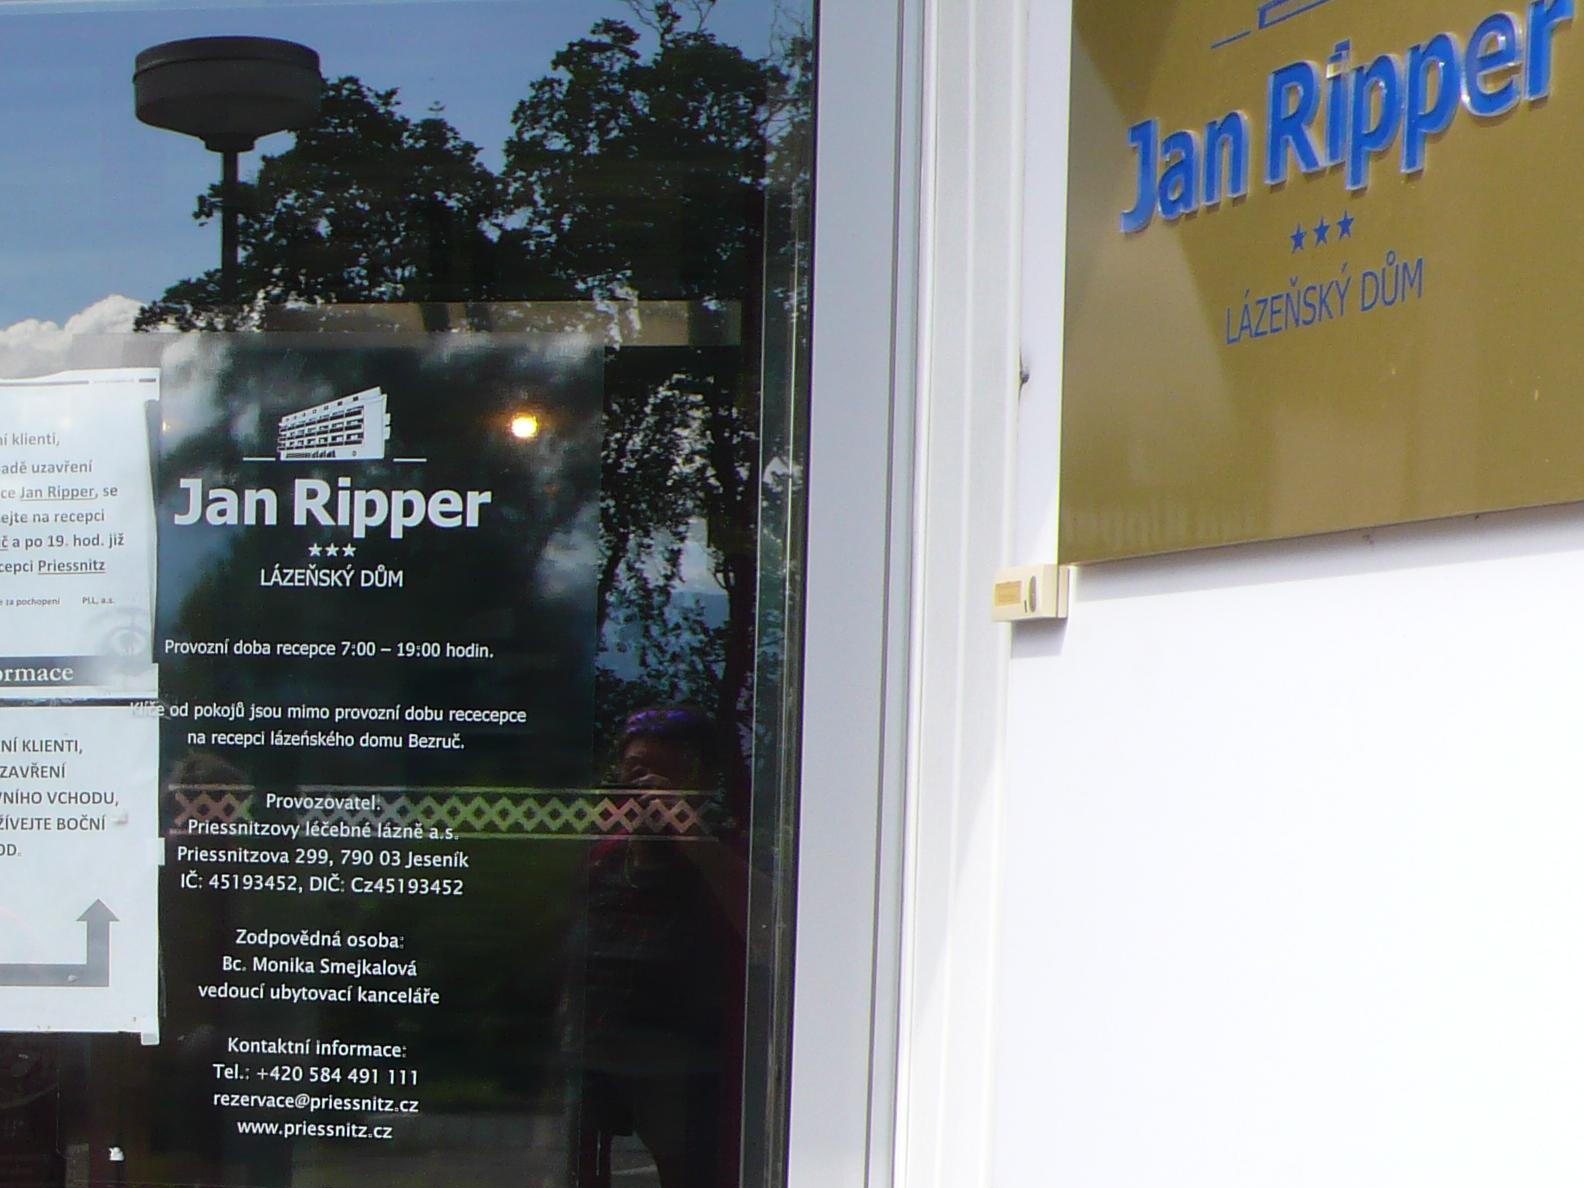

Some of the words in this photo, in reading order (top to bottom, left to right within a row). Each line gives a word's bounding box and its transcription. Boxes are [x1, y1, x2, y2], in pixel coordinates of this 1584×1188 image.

[1119, 106, 1250, 236] Jan
[1264, 0, 1575, 191] Ripper
[1225, 262, 1353, 345] LÁZEŇSKÝ
[1360, 249, 1424, 313] DŮM
[12, 432, 60, 446] klienti,
[31, 460, 92, 474] uzavření
[20, 488, 42, 499] Jan
[48, 486, 98, 499] Ripper,
[102, 486, 118, 496] se
[32, 513, 49, 523] na
[54, 509, 105, 525] recepci
[173, 478, 278, 526] Jan
[293, 477, 491, 539] Ripper
[12, 538, 20, 548] a
[25, 537, 42, 550] po
[47, 535, 68, 548] 19.
[73, 534, 104, 547] hod.
[108, 534, 124, 549] již
[38, 559, 105, 572] Priessnitz
[260, 564, 354, 588] LÁZEŇSKÝ
[361, 564, 403, 588] DŮM
[165, 639, 229, 655] Provozní
[234, 641, 271, 655] doba
[277, 643, 336, 661] recepce
[341, 642, 376, 657] 7:00
[397, 642, 441, 658] 19:00
[446, 643, 494, 659] hodin.
[170, 703, 189, 718] od
[194, 701, 245, 722] pokojů
[249, 705, 282, 721] jsou
[287, 706, 330, 720] mimo
[335, 705, 400, 723] provozní
[405, 706, 443, 722] dobu
[449, 709, 527, 725] rececepce
[23, 739, 83, 754] KLIENTI,
[188, 733, 206, 745] na
[211, 731, 265, 749] recepci
[359, 733, 402, 749] domu
[409, 733, 465, 750] Bezruč.
[47, 791, 119, 807] VCHODU,
[266, 793, 381, 812] Provozovatel:
[57, 814, 105, 831] BOČNÍ
[188, 819, 300, 840] Priessnitzovy
[305, 821, 371, 838] léčebné
[378, 822, 423, 839] lázně
[429, 826, 460, 841] a.s.
[177, 846, 289, 864] Priessnitzova
[295, 849, 335, 868] 299,
[340, 850, 373, 866] 790
[379, 850, 401, 867] 03
[405, 850, 469, 869] Jeseník
[181, 871, 203, 890] IČ:
[209, 874, 304, 893] 45193452,
[310, 873, 345, 893] DIČ:
[351, 877, 464, 895] Cz45193452
[236, 928, 341, 948] Zodpovědná
[347, 932, 404, 949] osoba:
[222, 956, 247, 972] Bc.
[252, 957, 315, 975] Monika
[320, 959, 417, 978] Smejkalová
[198, 982, 265, 1000] vedoucí
[270, 984, 351, 1004] ubytovací
[358, 988, 440, 1006] kanceláře
[228, 1037, 311, 1055] Kontaktní
[316, 1039, 408, 1058] informace:
[213, 1064, 249, 1081] Tel.:
[257, 1066, 303, 1082] +420
[309, 1067, 342, 1084] 584
[347, 1068, 379, 1084] 491
[388, 1069, 418, 1086] 111
[214, 1091, 419, 1113] rezervace@priessnitz.cz
[237, 1119, 393, 1140] www.priessnitz.cz
